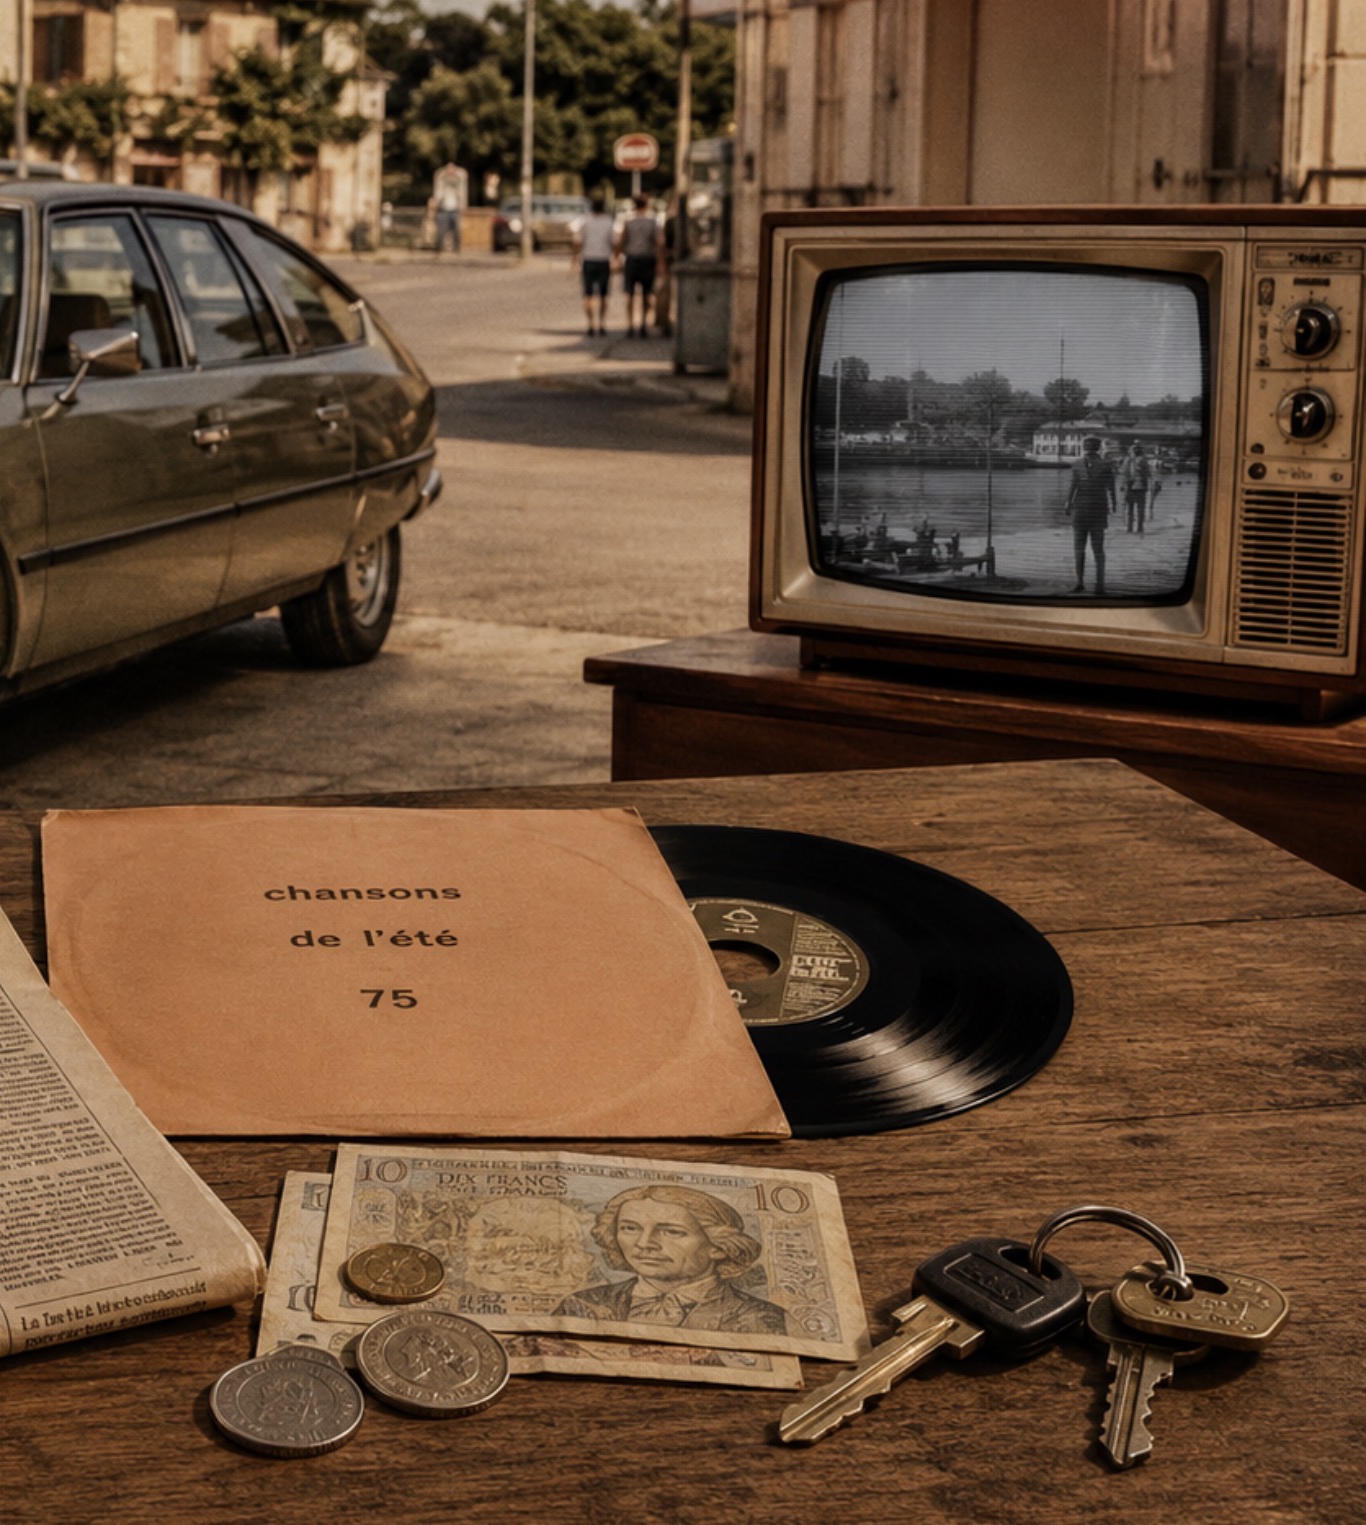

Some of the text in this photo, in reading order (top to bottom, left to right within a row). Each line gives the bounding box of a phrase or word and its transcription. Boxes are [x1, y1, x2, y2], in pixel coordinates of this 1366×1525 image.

[264, 885, 462, 901] chansons
[290, 930, 341, 947] de
[360, 989, 418, 1009] 75
[358, 1157, 408, 1183] 10
[436, 1171, 477, 1186] DIX
[754, 1183, 810, 1214] 10
